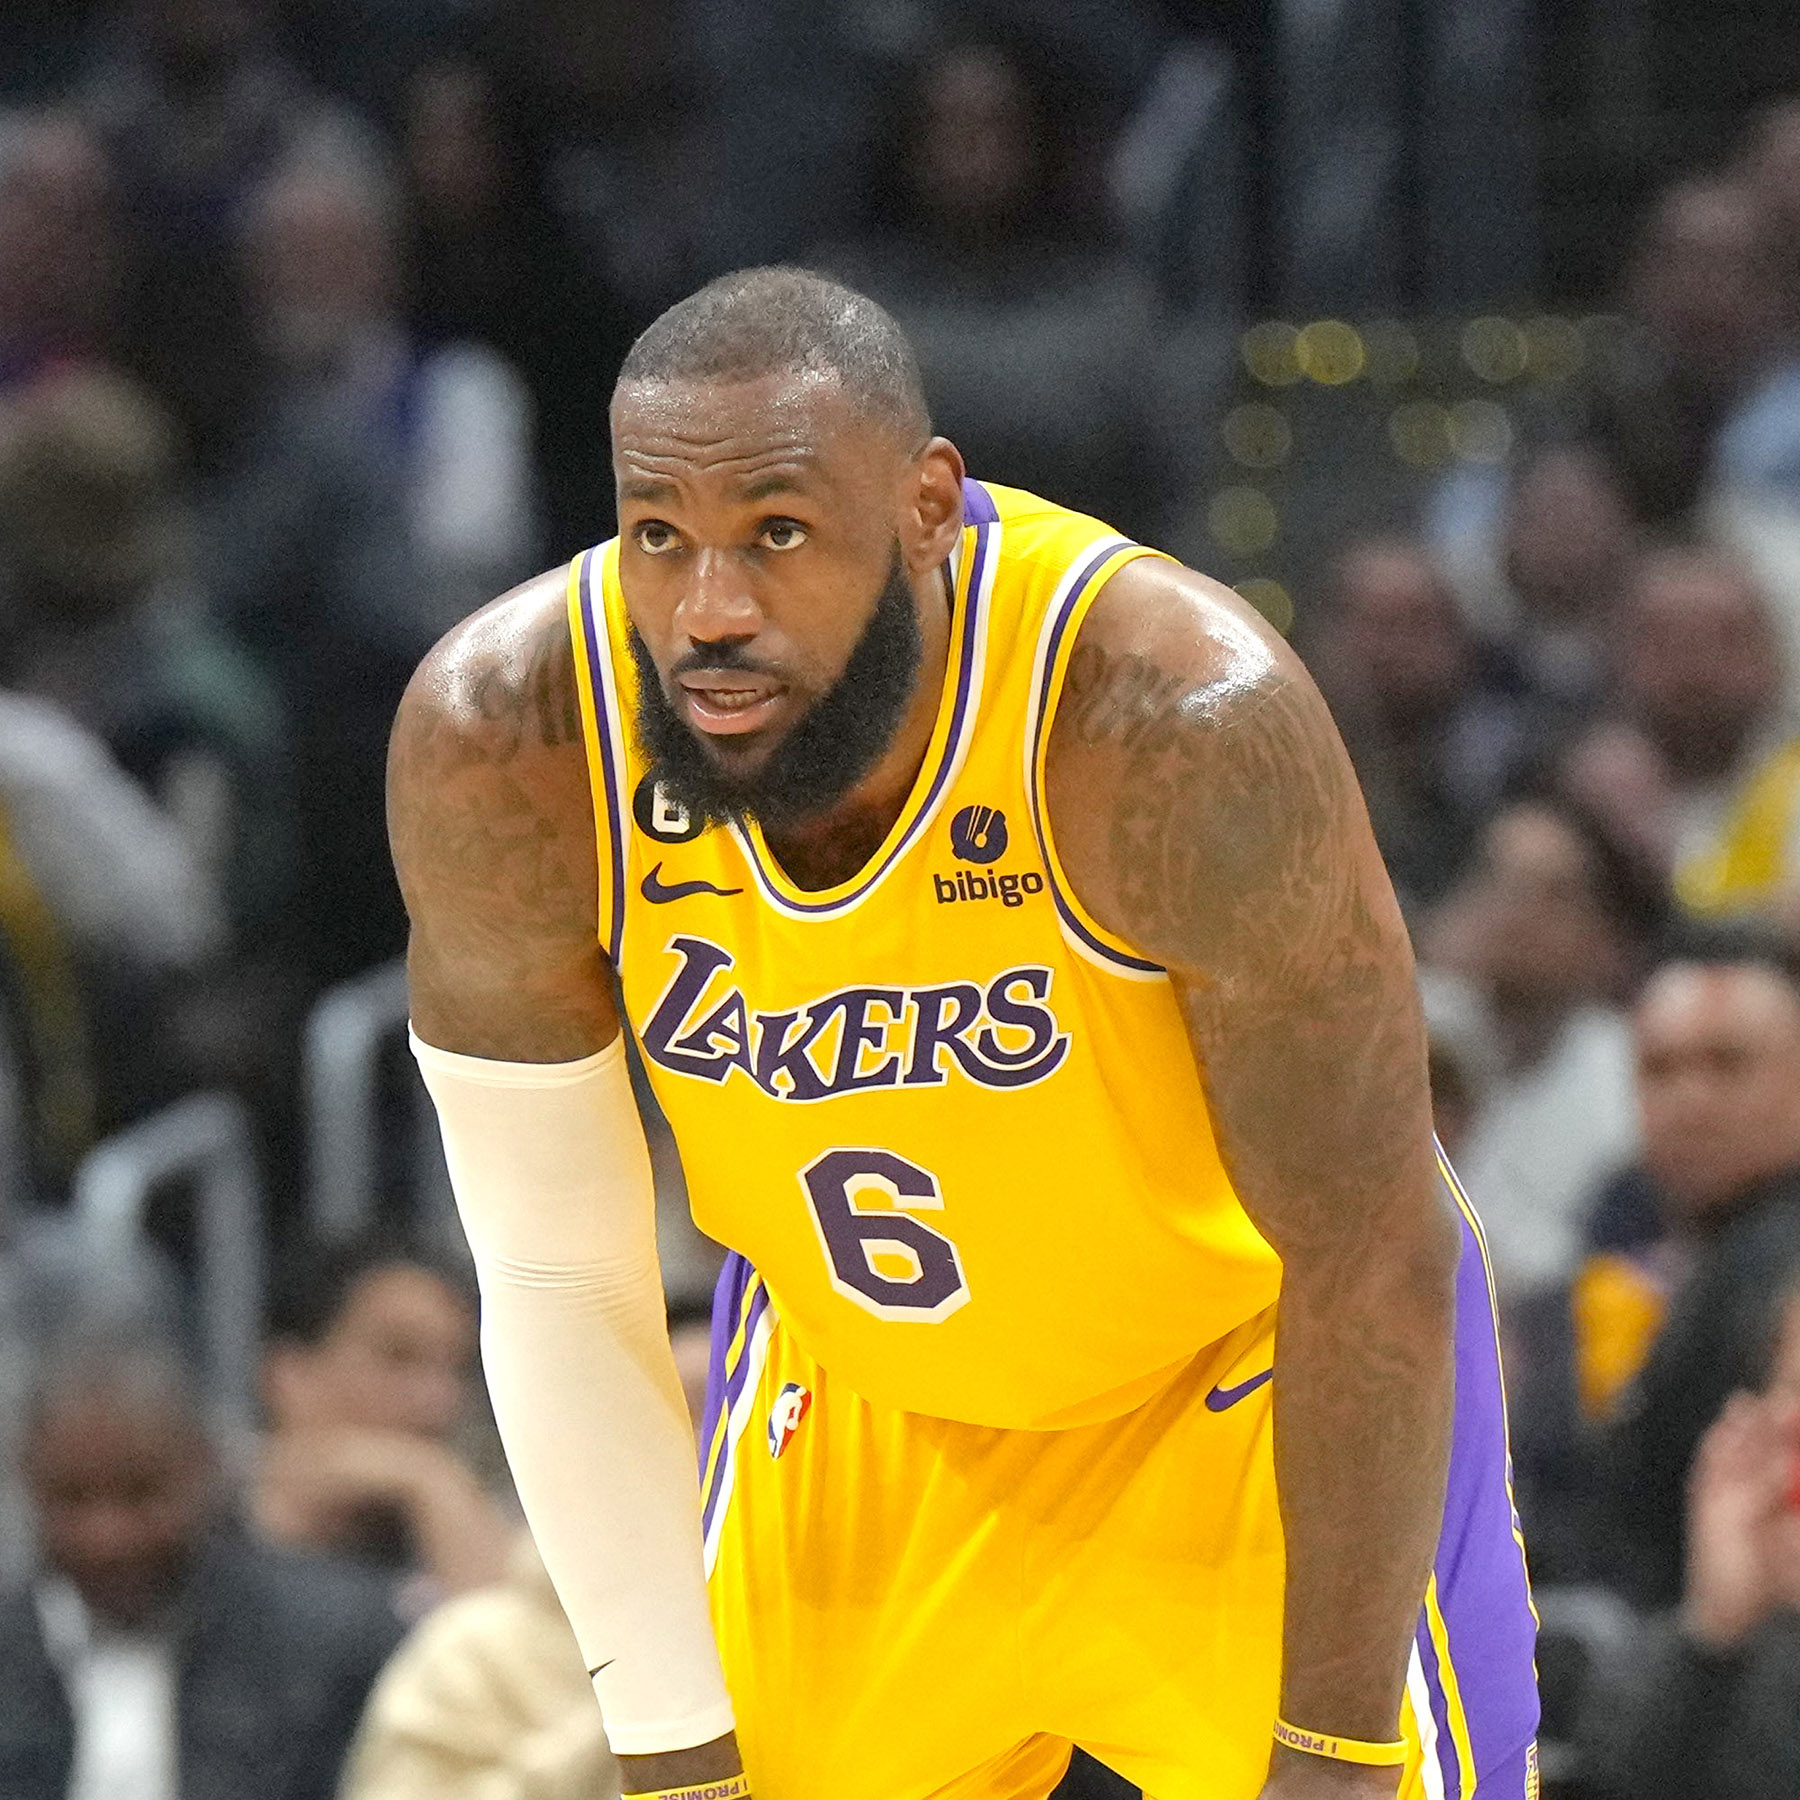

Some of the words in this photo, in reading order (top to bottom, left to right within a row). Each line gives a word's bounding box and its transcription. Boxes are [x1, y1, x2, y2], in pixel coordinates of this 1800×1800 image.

[933, 868, 1044, 908] bibigo
[638, 932, 1073, 1105] LAKERS
[795, 1145, 972, 1324] 6
[743, 1778, 749, 1791] I
